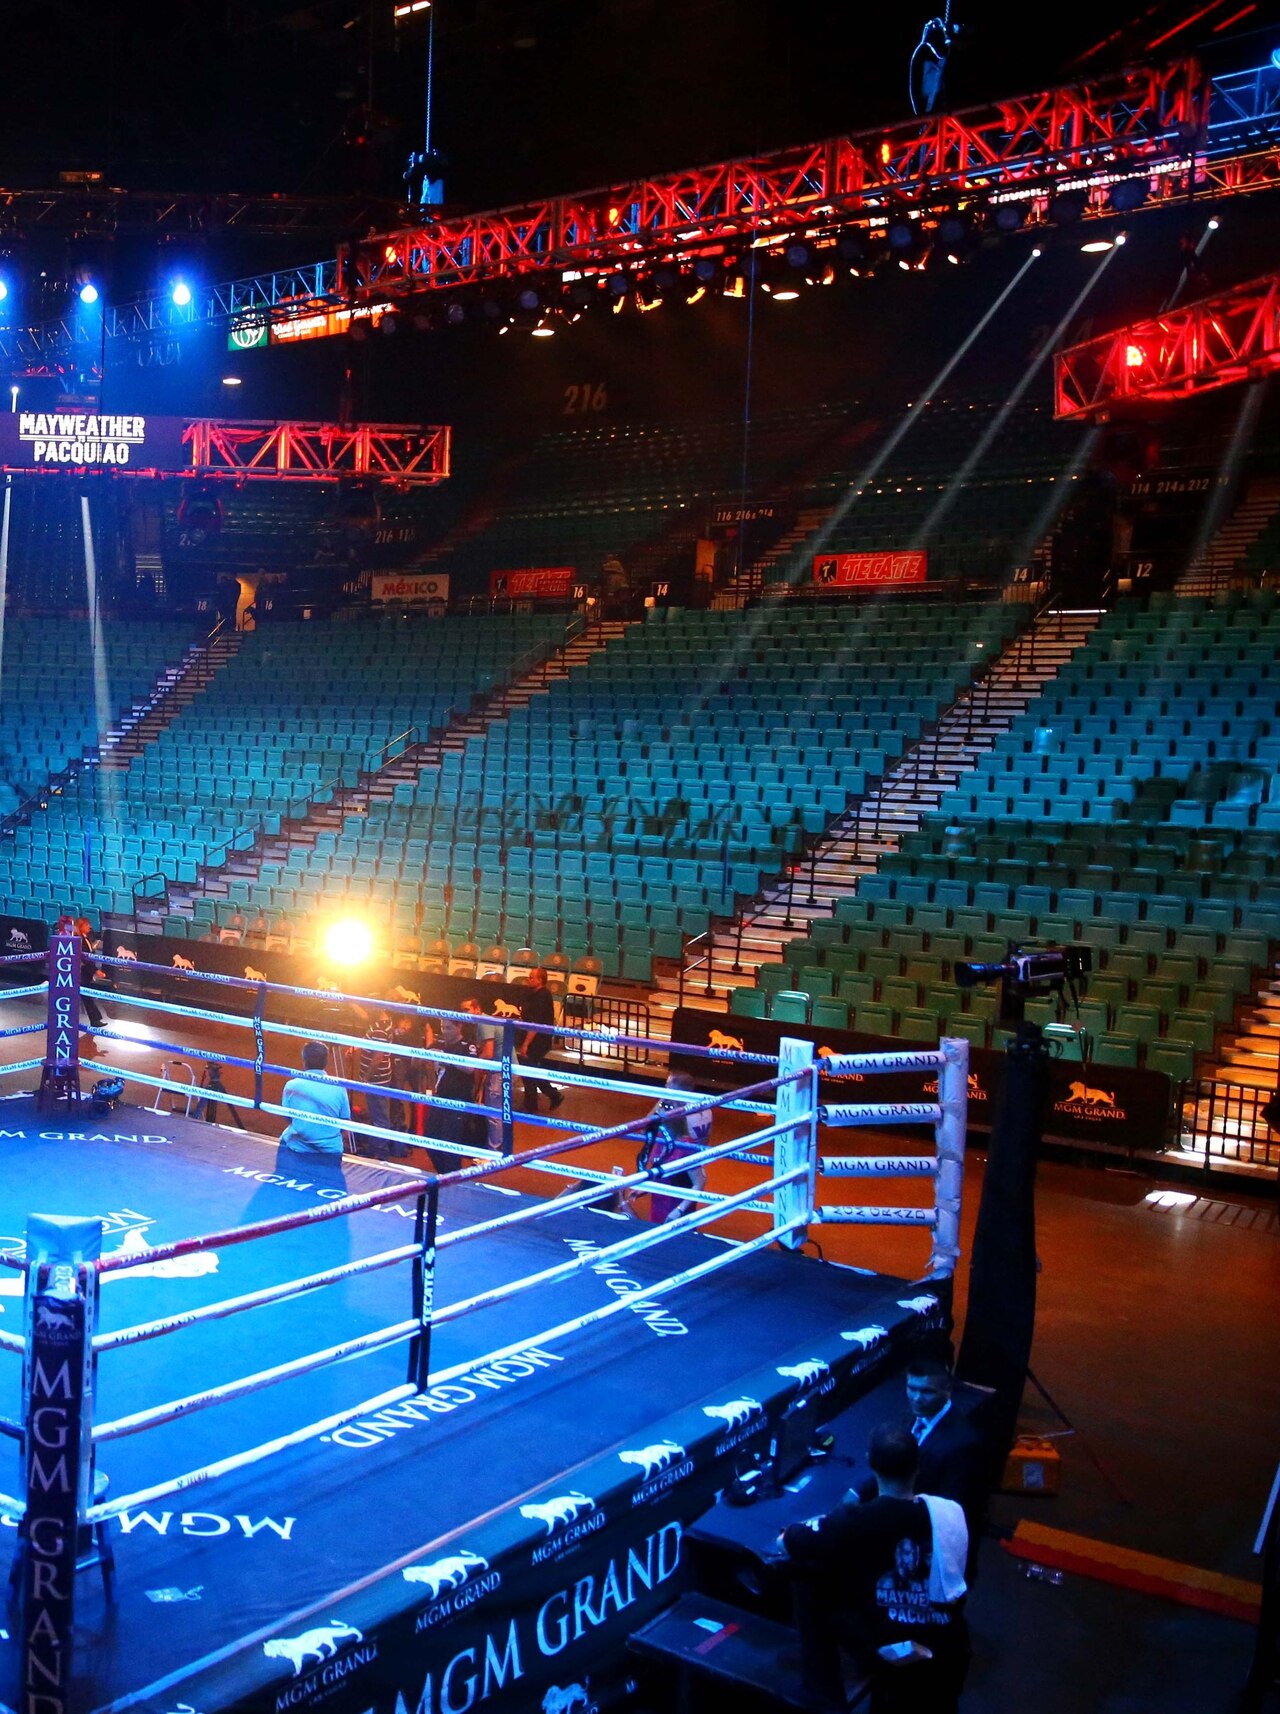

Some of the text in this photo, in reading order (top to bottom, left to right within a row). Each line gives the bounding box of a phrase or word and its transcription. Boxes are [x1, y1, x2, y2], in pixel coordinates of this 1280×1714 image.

[562, 382, 608, 415] 216
[19, 413, 145, 437] MAYWEATHER
[33, 441, 130, 464] PACQUIAO
[1131, 483, 1150, 495] 114
[1156, 482, 1178, 494] 214
[1188, 478, 1209, 492] 212
[735, 510, 751, 521] 216
[374, 529, 393, 544] 216
[842, 555, 922, 581] TECATE
[1013, 567, 1028, 582] 14
[1136, 563, 1152, 578] 12
[573, 585, 583, 598] 16
[657, 583, 668, 596] 14
[56, 941, 75, 988] MGM
[554, 1027, 616, 1042] MGM GRAND
[709, 1048, 738, 1059] MGM
[740, 1052, 779, 1064] GRAND
[838, 1054, 939, 1070] MGM GRAND
[502, 1055, 511, 1123] MGM GRAND
[923, 1084, 939, 1094] MG
[834, 1106, 875, 1119] MGM
[830, 1158, 931, 1172] MGM GRAND
[222, 1165, 313, 1192] MGM
[422, 1266, 436, 1327] TECATE
[459, 1346, 564, 1392] MGM
[30, 1358, 73, 1494] MGM
[631, 1461, 695, 1508] MGM GRAND
[118, 1509, 297, 1541] MGM
[531, 1511, 606, 1567] MGM GRAND
[414, 1571, 502, 1634] MGM GRAND
[876, 1589, 927, 1607] MAYWE
[394, 1520, 684, 1714] MGM GRAND
[275, 1642, 379, 1714] MGM GRAND
